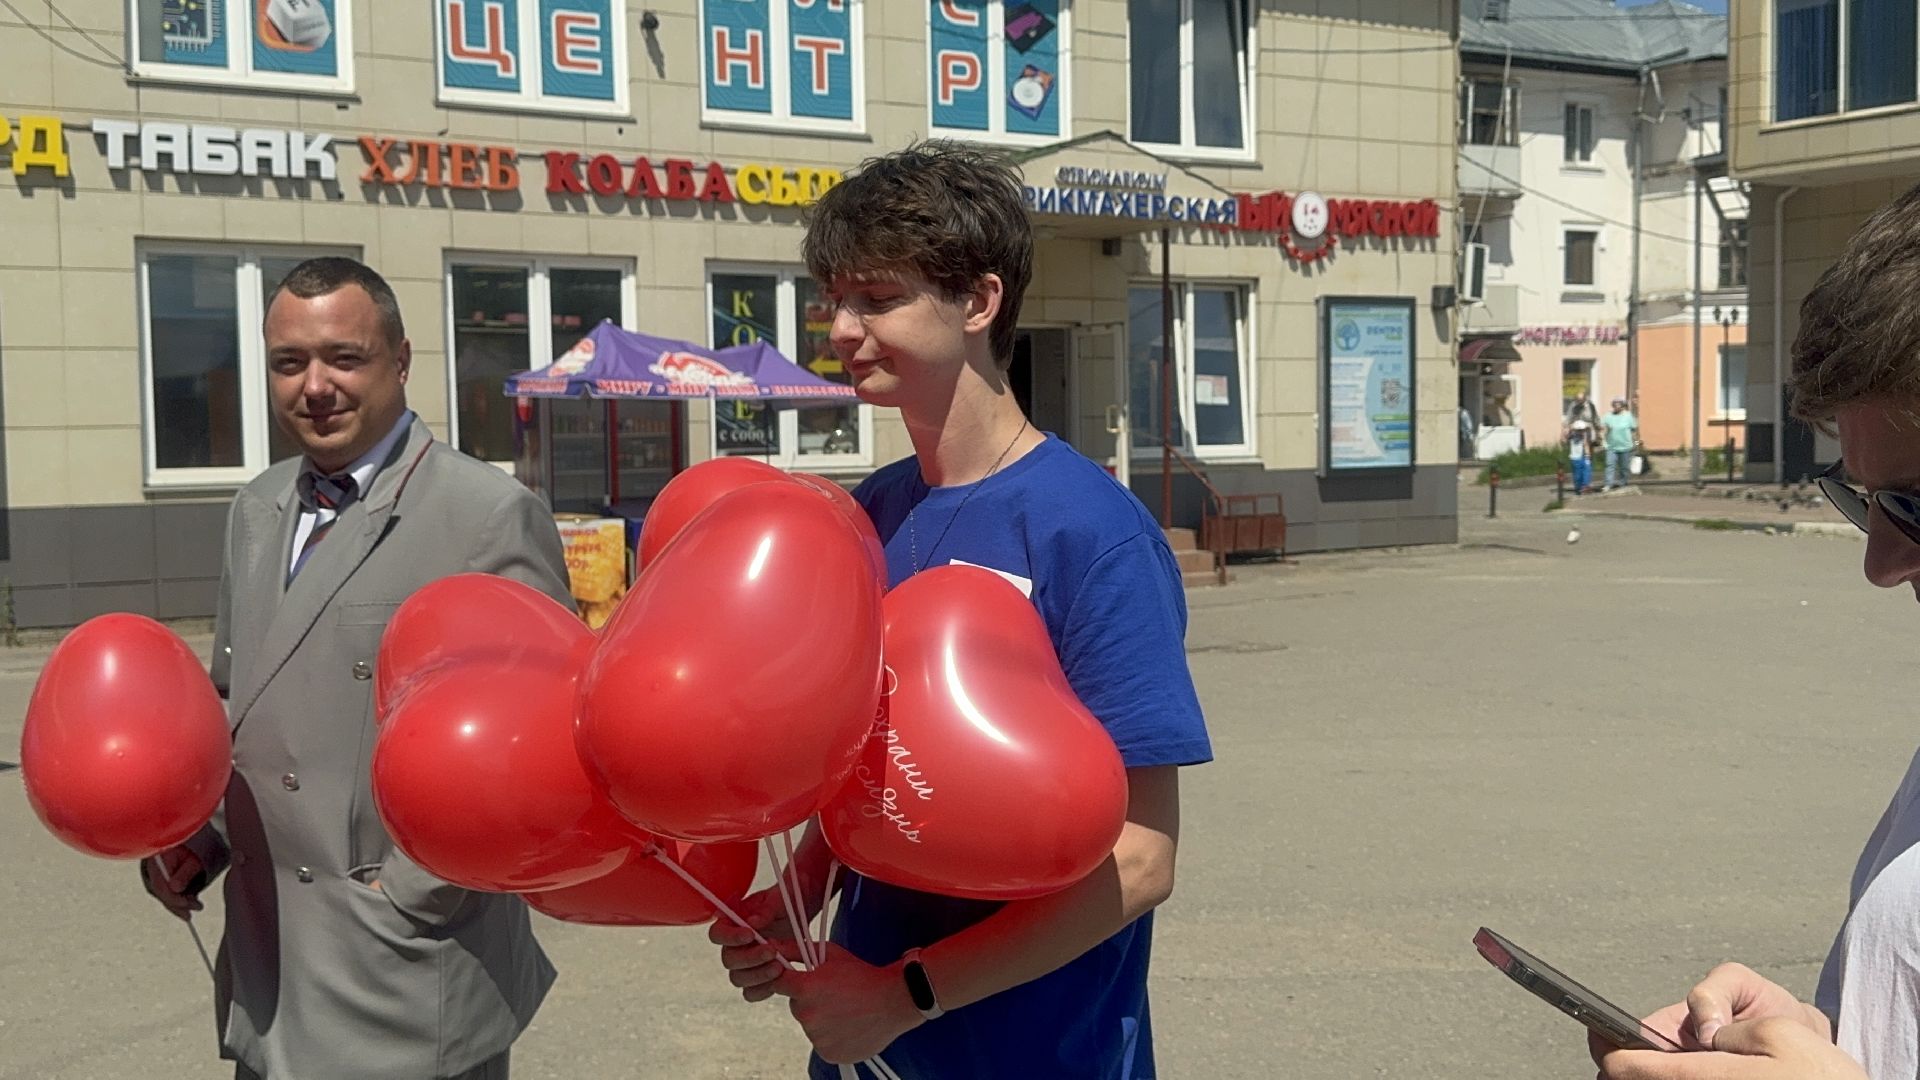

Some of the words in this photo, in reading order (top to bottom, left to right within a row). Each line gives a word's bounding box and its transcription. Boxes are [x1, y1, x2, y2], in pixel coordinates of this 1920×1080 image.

[0, 114, 69, 177] Д
[92, 118, 337, 180] ТАБАК
[358, 136, 519, 191] ХЛЕБ
[1328, 198, 1439, 239] МЯСНОЙ
